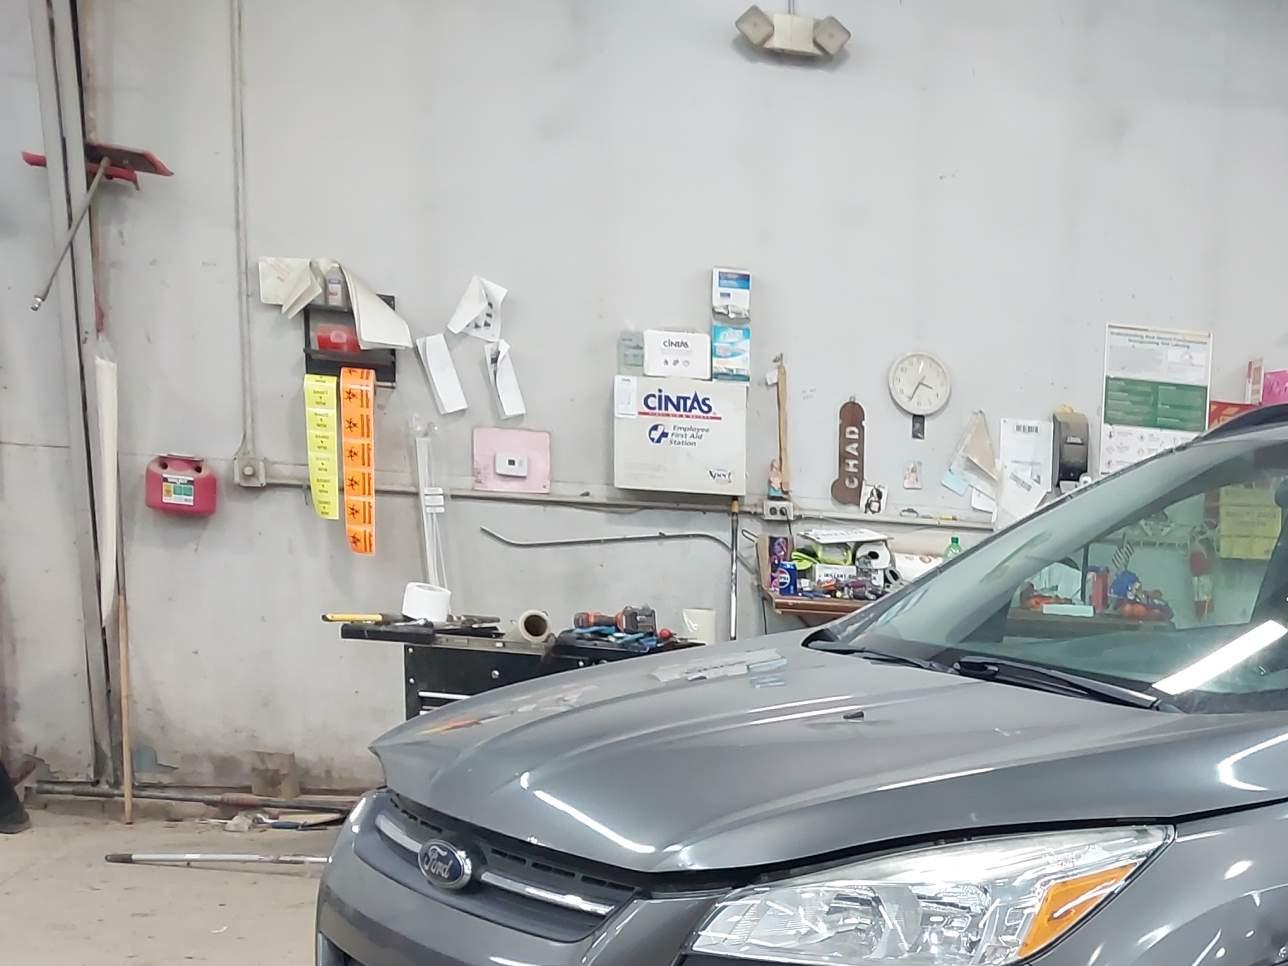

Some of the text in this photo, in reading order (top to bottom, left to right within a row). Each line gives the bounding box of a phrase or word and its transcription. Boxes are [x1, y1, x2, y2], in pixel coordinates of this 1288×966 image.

[643, 388, 712, 415] CINTAS
[669, 439, 697, 447] Station
[672, 425, 710, 434] Employee
[845, 426, 859, 489] CHAD
[424, 845, 453, 878] Ford
